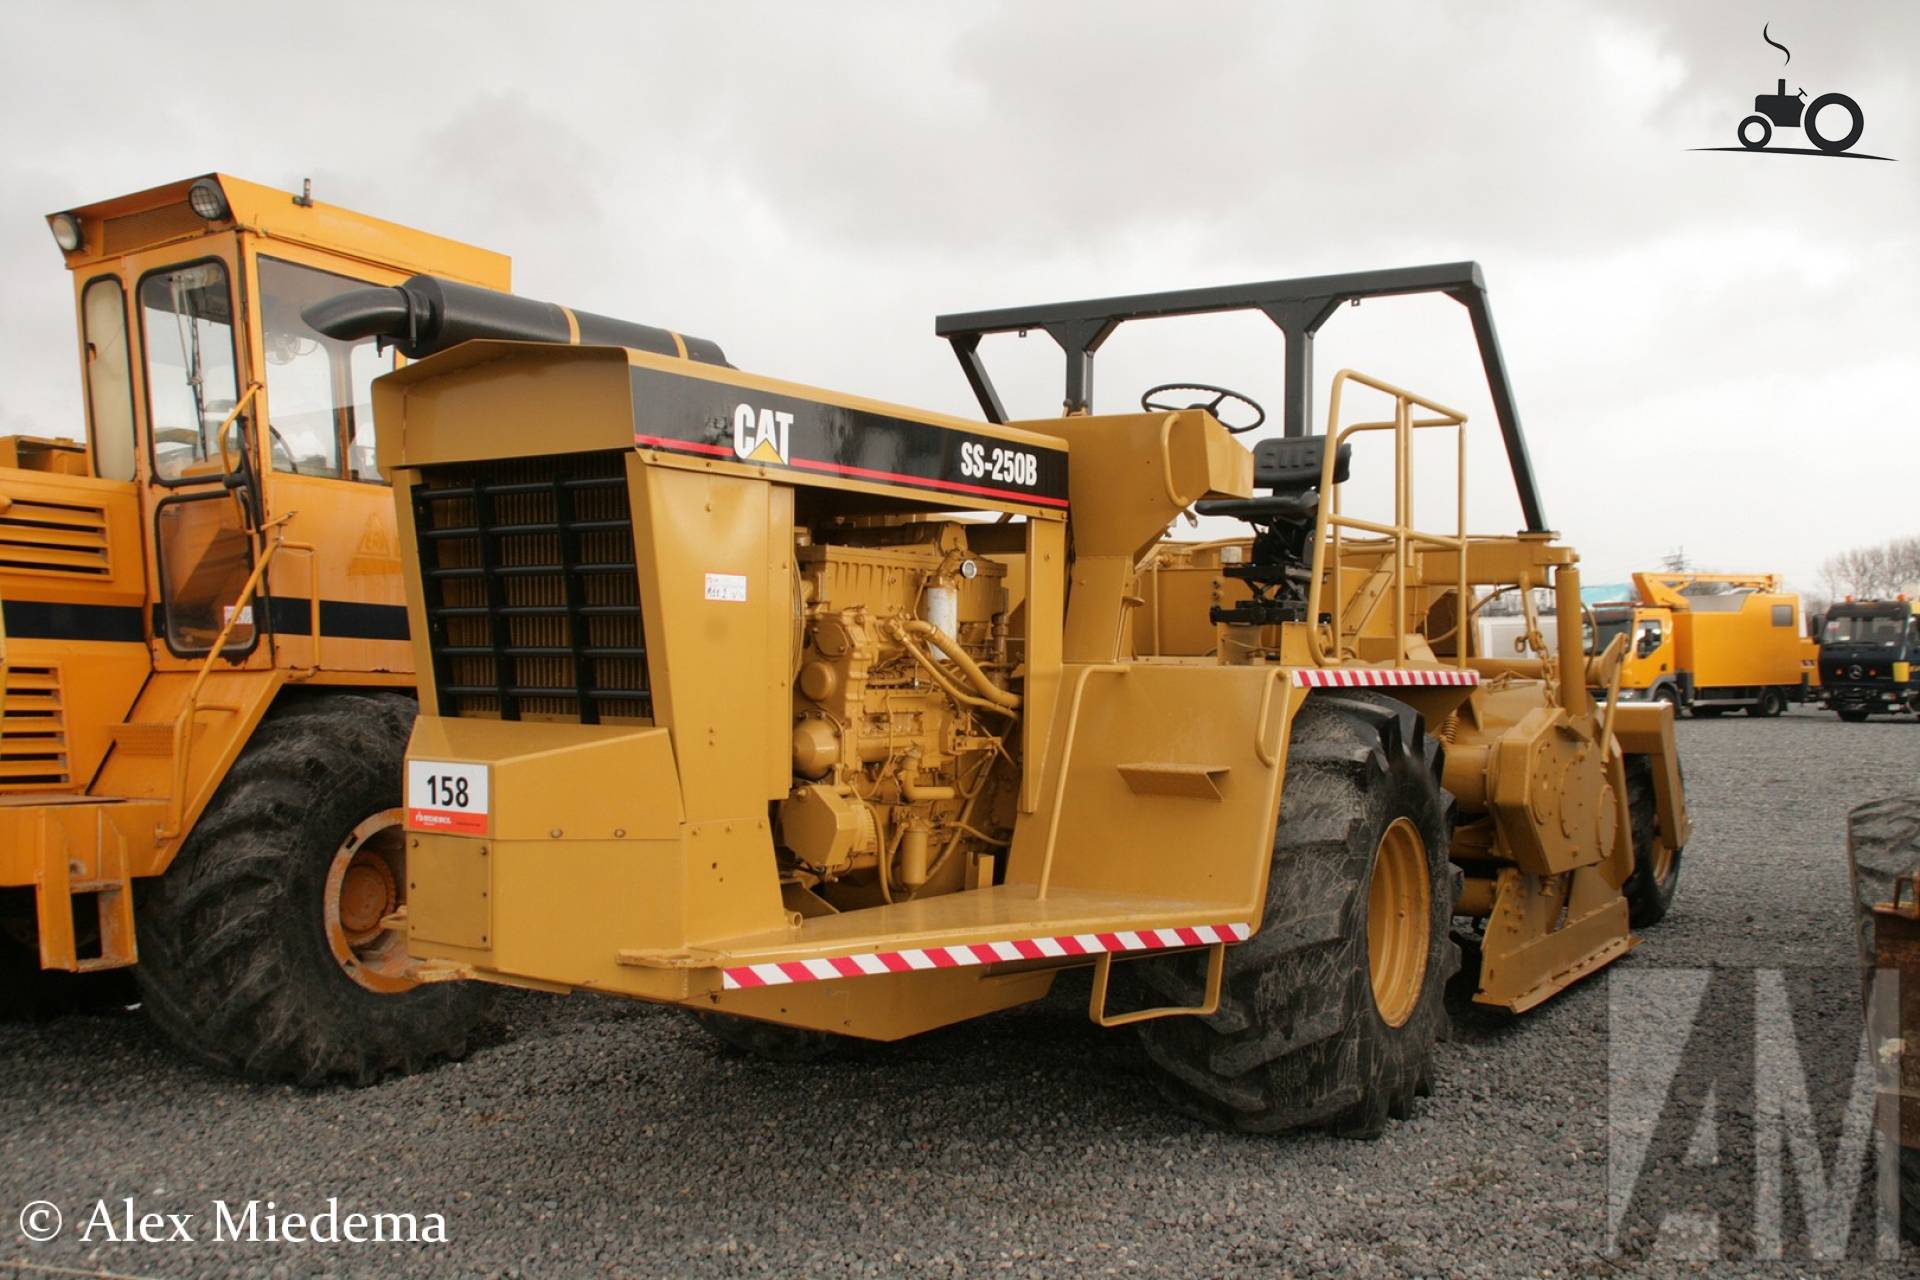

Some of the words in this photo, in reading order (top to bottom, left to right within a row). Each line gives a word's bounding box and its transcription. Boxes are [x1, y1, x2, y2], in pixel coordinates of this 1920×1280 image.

[733, 403, 795, 466] CAT
[960, 441, 1038, 487] SS-250B
[426, 774, 469, 808] 158
